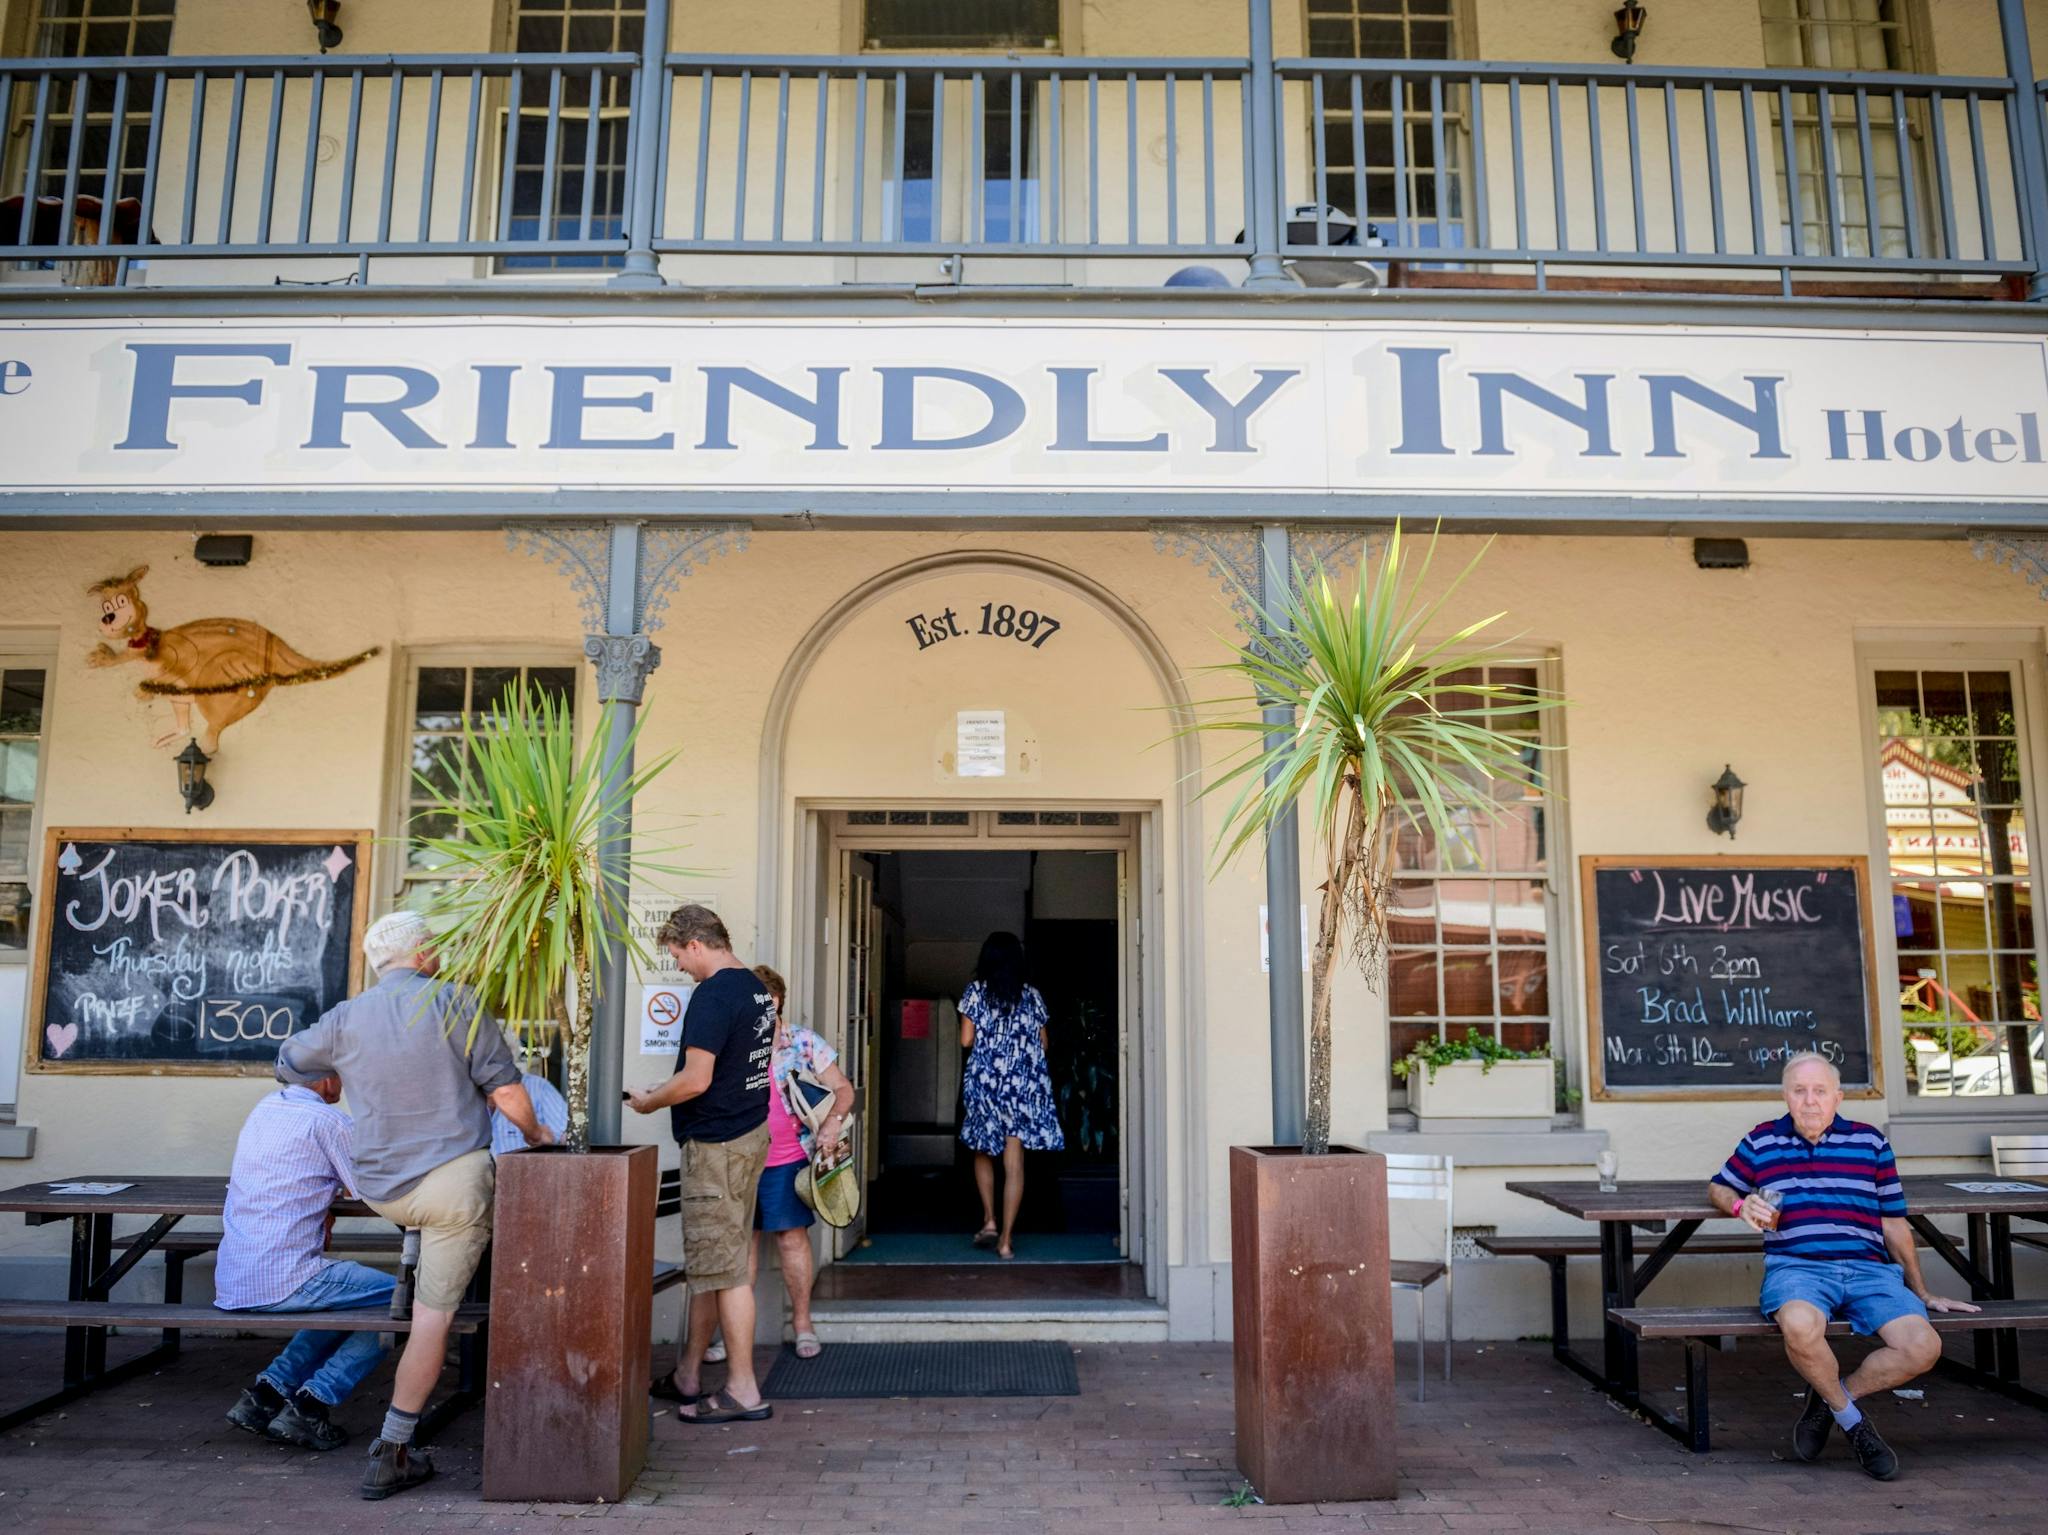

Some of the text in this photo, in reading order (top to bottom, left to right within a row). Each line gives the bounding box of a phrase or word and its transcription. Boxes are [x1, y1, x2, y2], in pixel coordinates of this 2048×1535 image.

[113, 343, 1301, 453] FRIENDLY
[1386, 347, 1792, 459] INN
[1821, 409, 2047, 464] Hotel
[905, 602, 1061, 651] Est. 1897
[65, 848, 332, 950] JOKER POKER
[93, 930, 293, 999] Thursday nights
[1606, 941, 1648, 974] Sat
[1658, 943, 1699, 976] 6th
[1637, 987, 1709, 1025] Brad
[657, 1030, 669, 1038] NO
